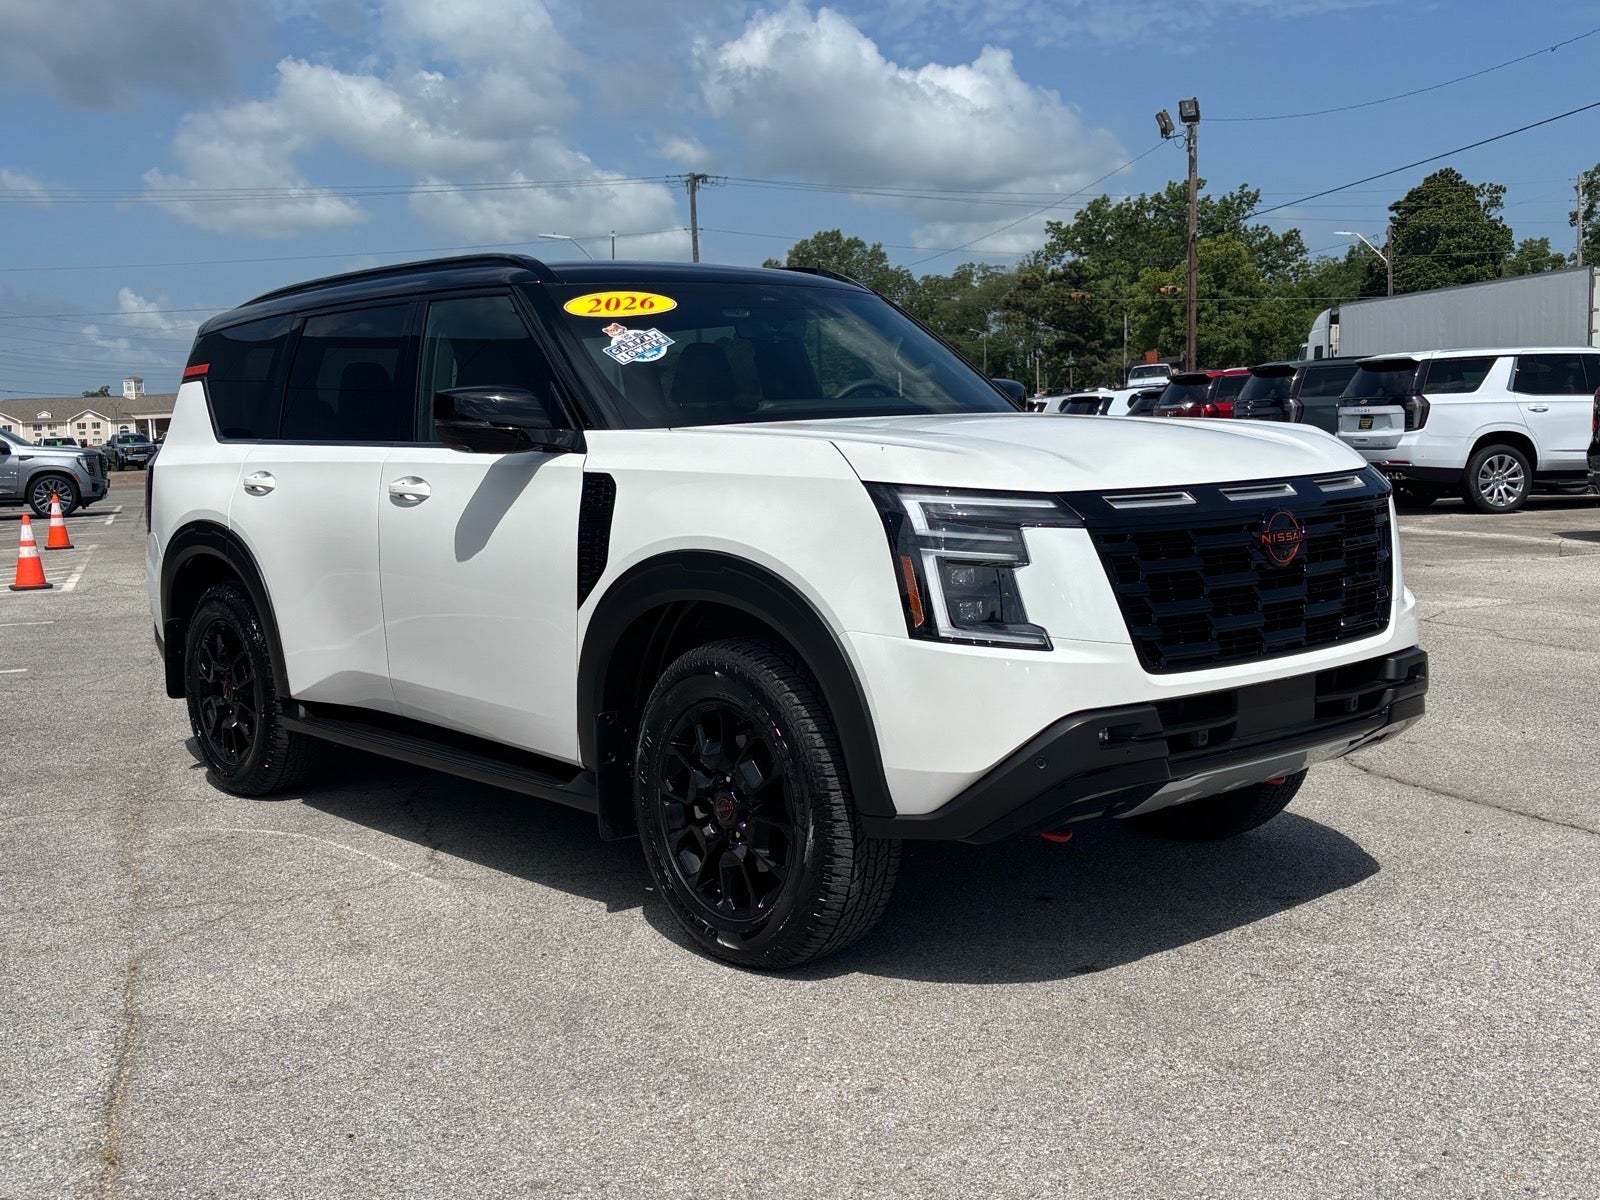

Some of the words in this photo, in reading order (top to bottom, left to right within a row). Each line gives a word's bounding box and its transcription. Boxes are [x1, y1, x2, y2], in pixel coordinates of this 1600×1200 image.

[587, 296, 654, 313] 2026
[611, 333, 658, 354] CARFAX
[1261, 532, 1303, 543] NISSAN
